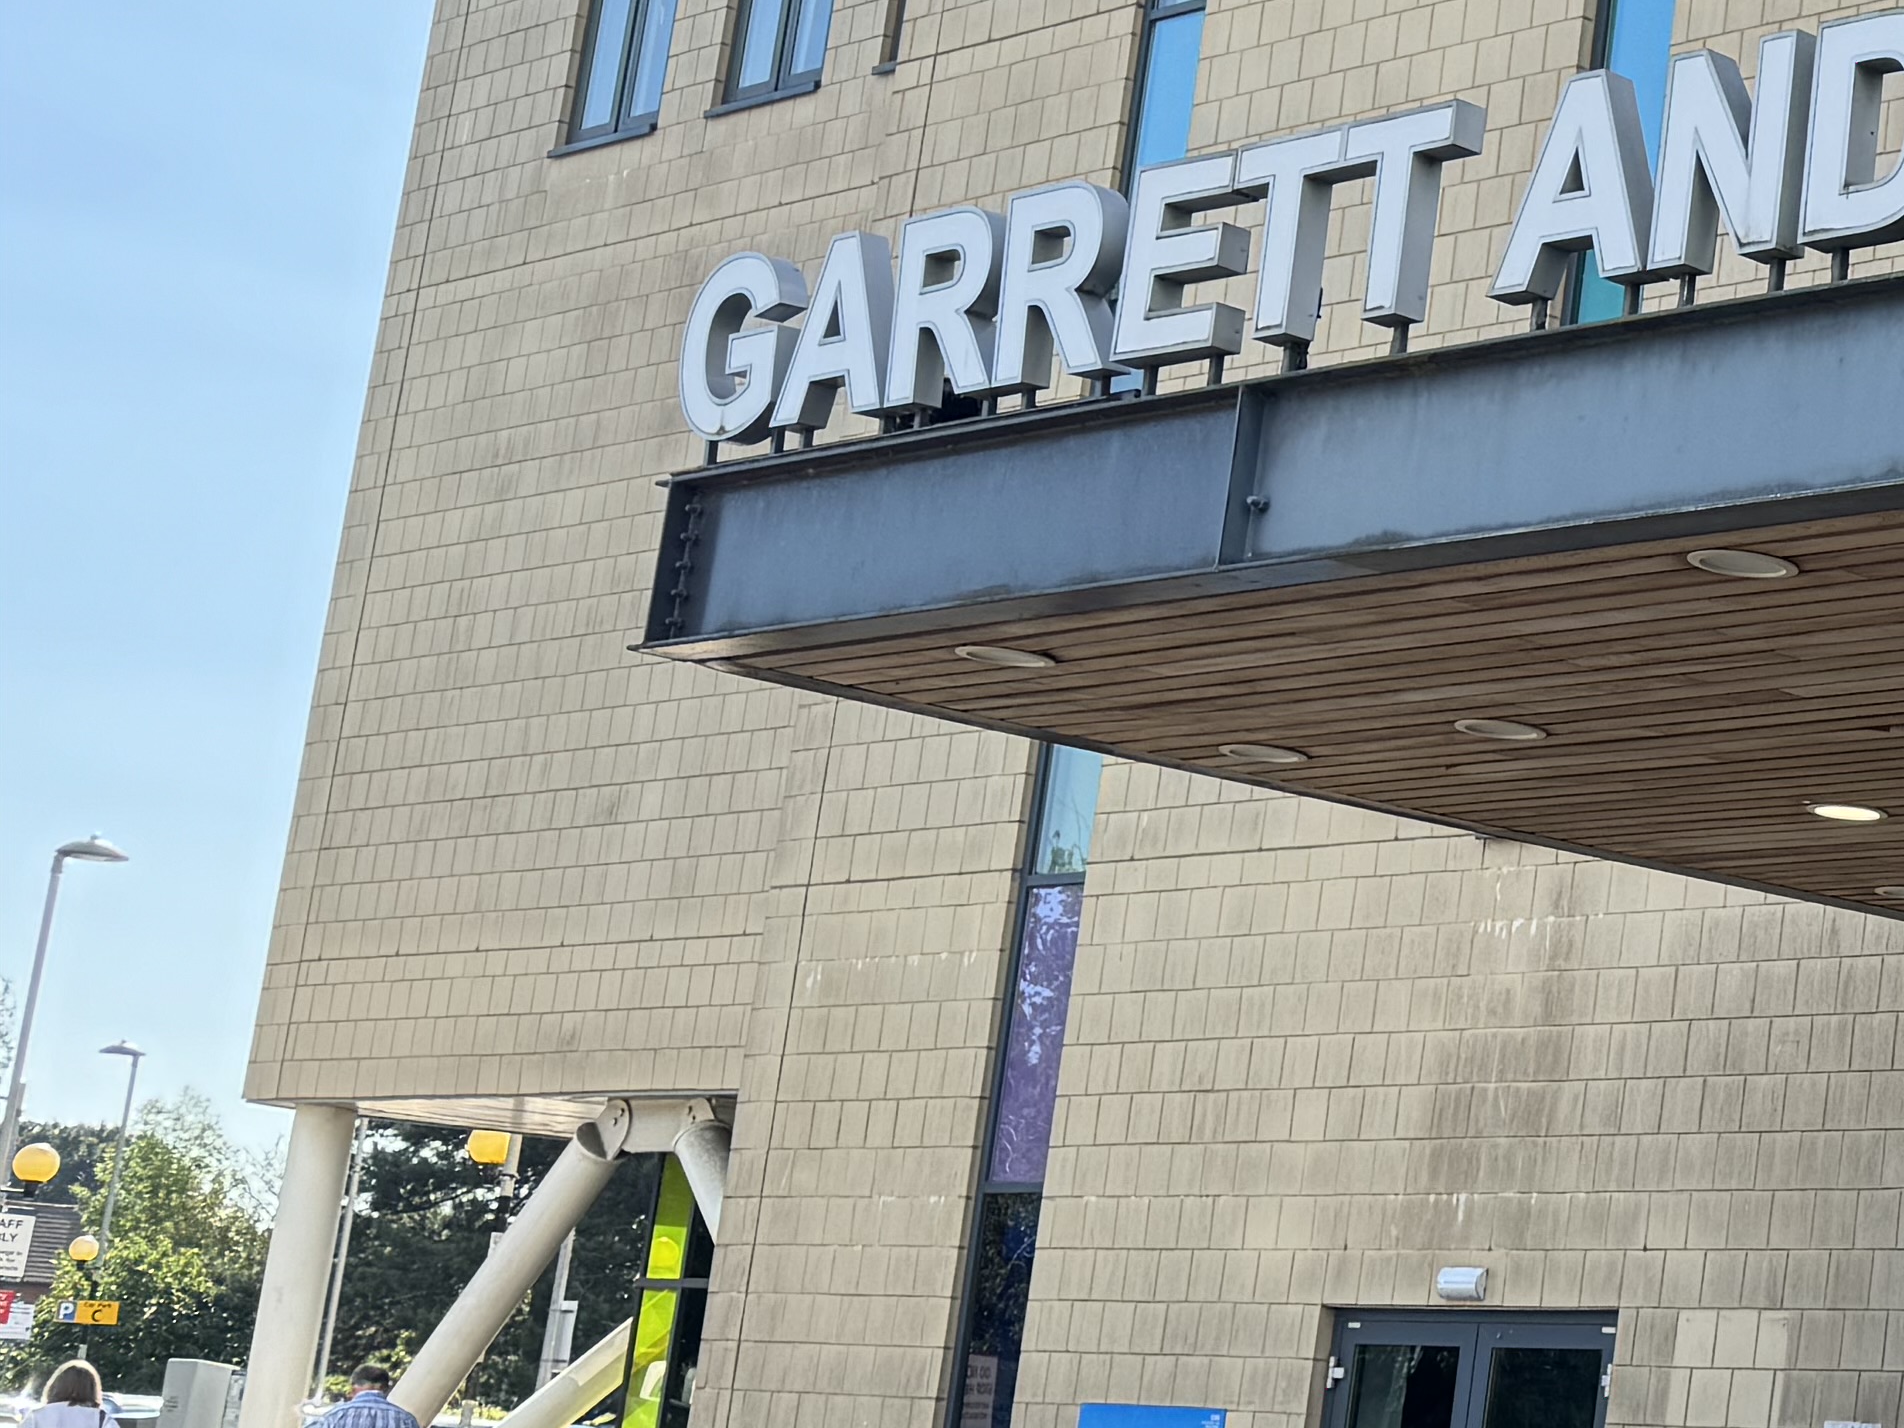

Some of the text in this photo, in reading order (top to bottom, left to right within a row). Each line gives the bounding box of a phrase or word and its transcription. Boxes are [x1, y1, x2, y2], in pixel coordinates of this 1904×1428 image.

[678, 97, 1487, 444] GARRETT
[59, 1302, 74, 1320] P
[91, 1309, 102, 1322] C
